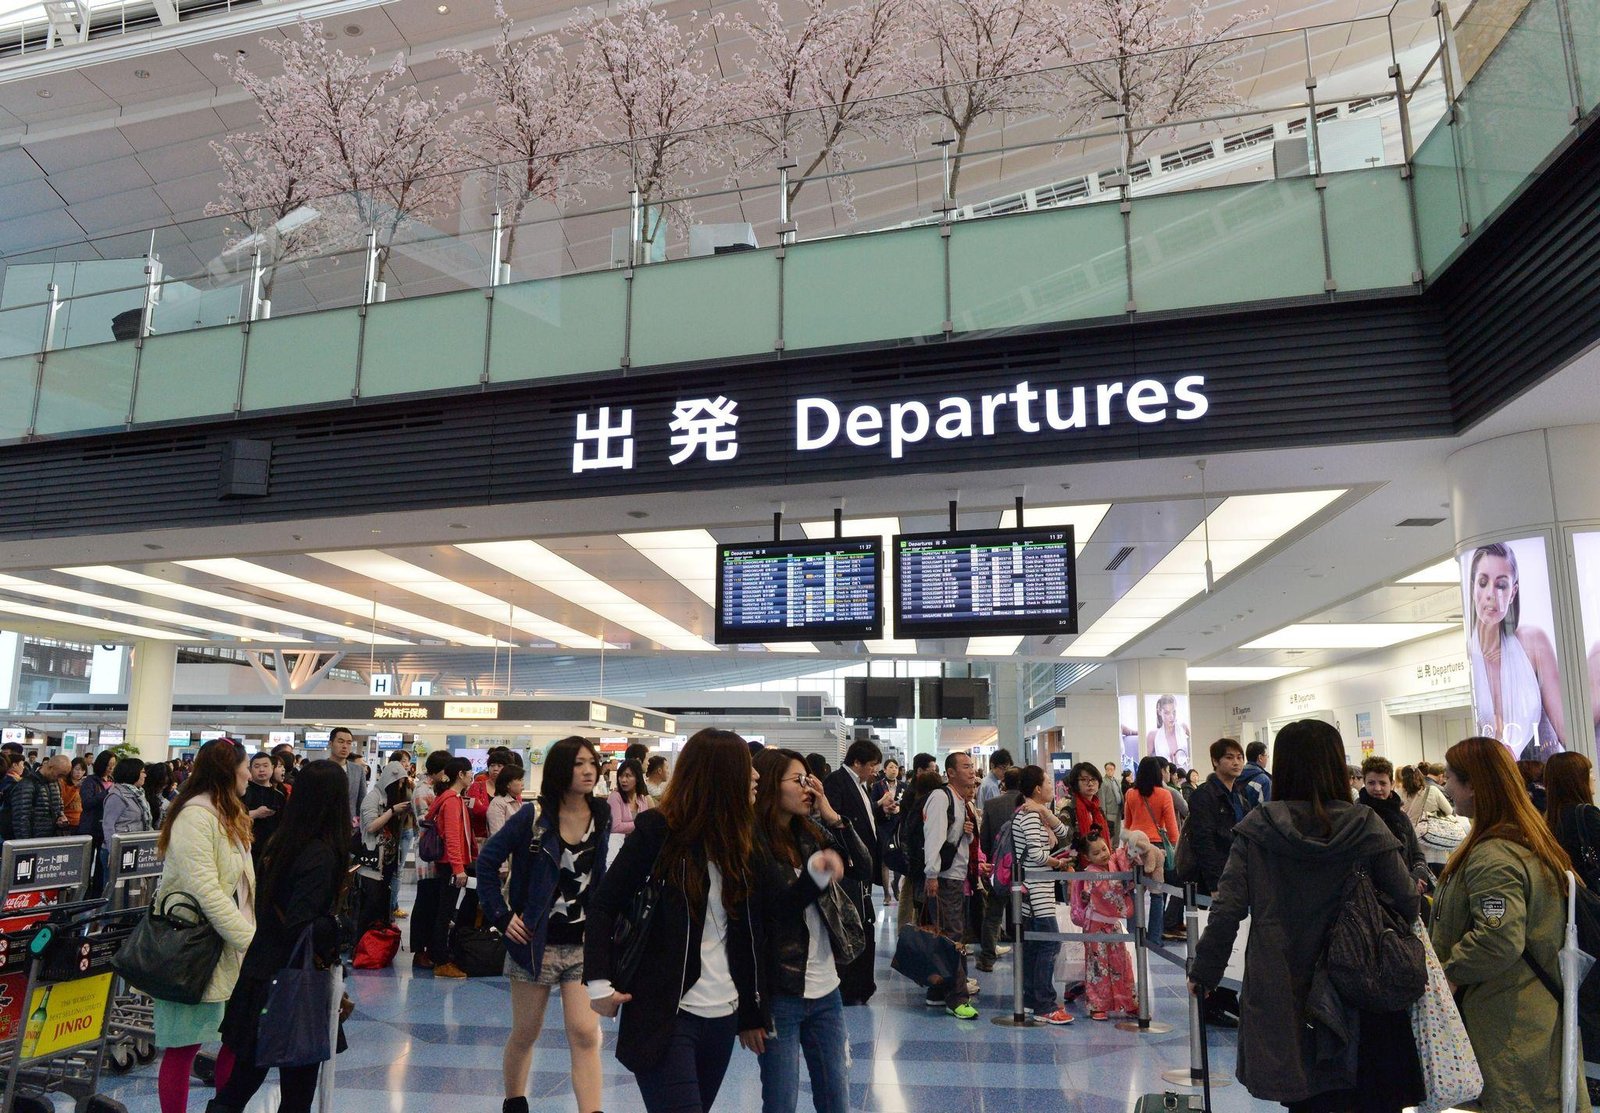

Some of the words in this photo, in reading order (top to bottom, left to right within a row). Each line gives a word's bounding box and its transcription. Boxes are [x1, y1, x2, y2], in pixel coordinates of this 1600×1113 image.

[572, 395, 739, 474] 出発
[796, 375, 1209, 458] Departures
[1432, 662, 1464, 677] Departures
[375, 679, 386, 692] H
[374, 708, 428, 718] 海外旅行保険
[49, 863, 61, 871] Pool
[53, 1015, 92, 1041] JINRO
